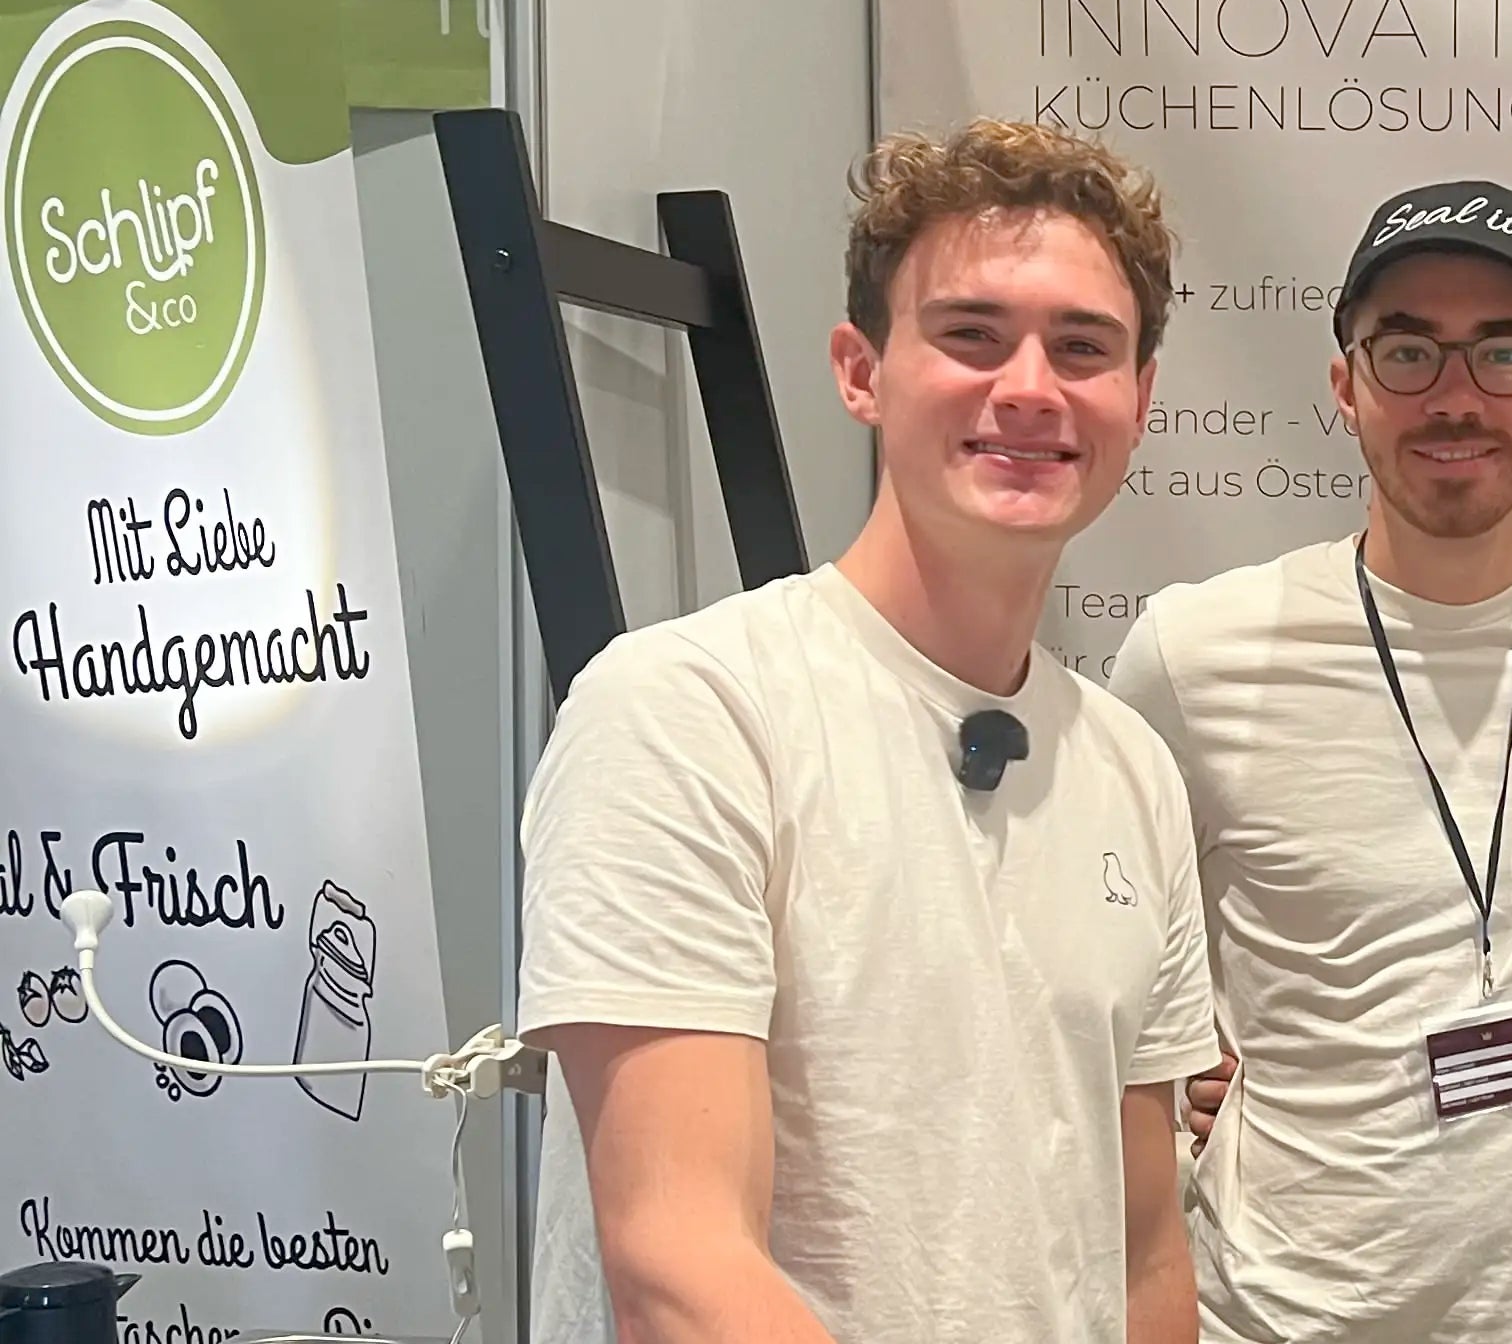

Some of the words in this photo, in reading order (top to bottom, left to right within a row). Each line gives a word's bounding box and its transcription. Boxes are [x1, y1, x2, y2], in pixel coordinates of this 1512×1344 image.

[40, 158, 219, 284] Schlipf
[1372, 196, 1489, 247] Seal
[1147, 400, 1273, 435] änder
[1168, 470, 1243, 497] aus
[1256, 458, 1370, 498] Öster
[86, 496, 154, 584] Mit
[163, 487, 276, 576] Liebe
[12, 583, 371, 740] Handgemacht
[92, 830, 285, 929] Frisch
[20, 1195, 190, 1265] Kommen
[197, 1209, 254, 1269] die
[256, 1210, 389, 1276] besten
